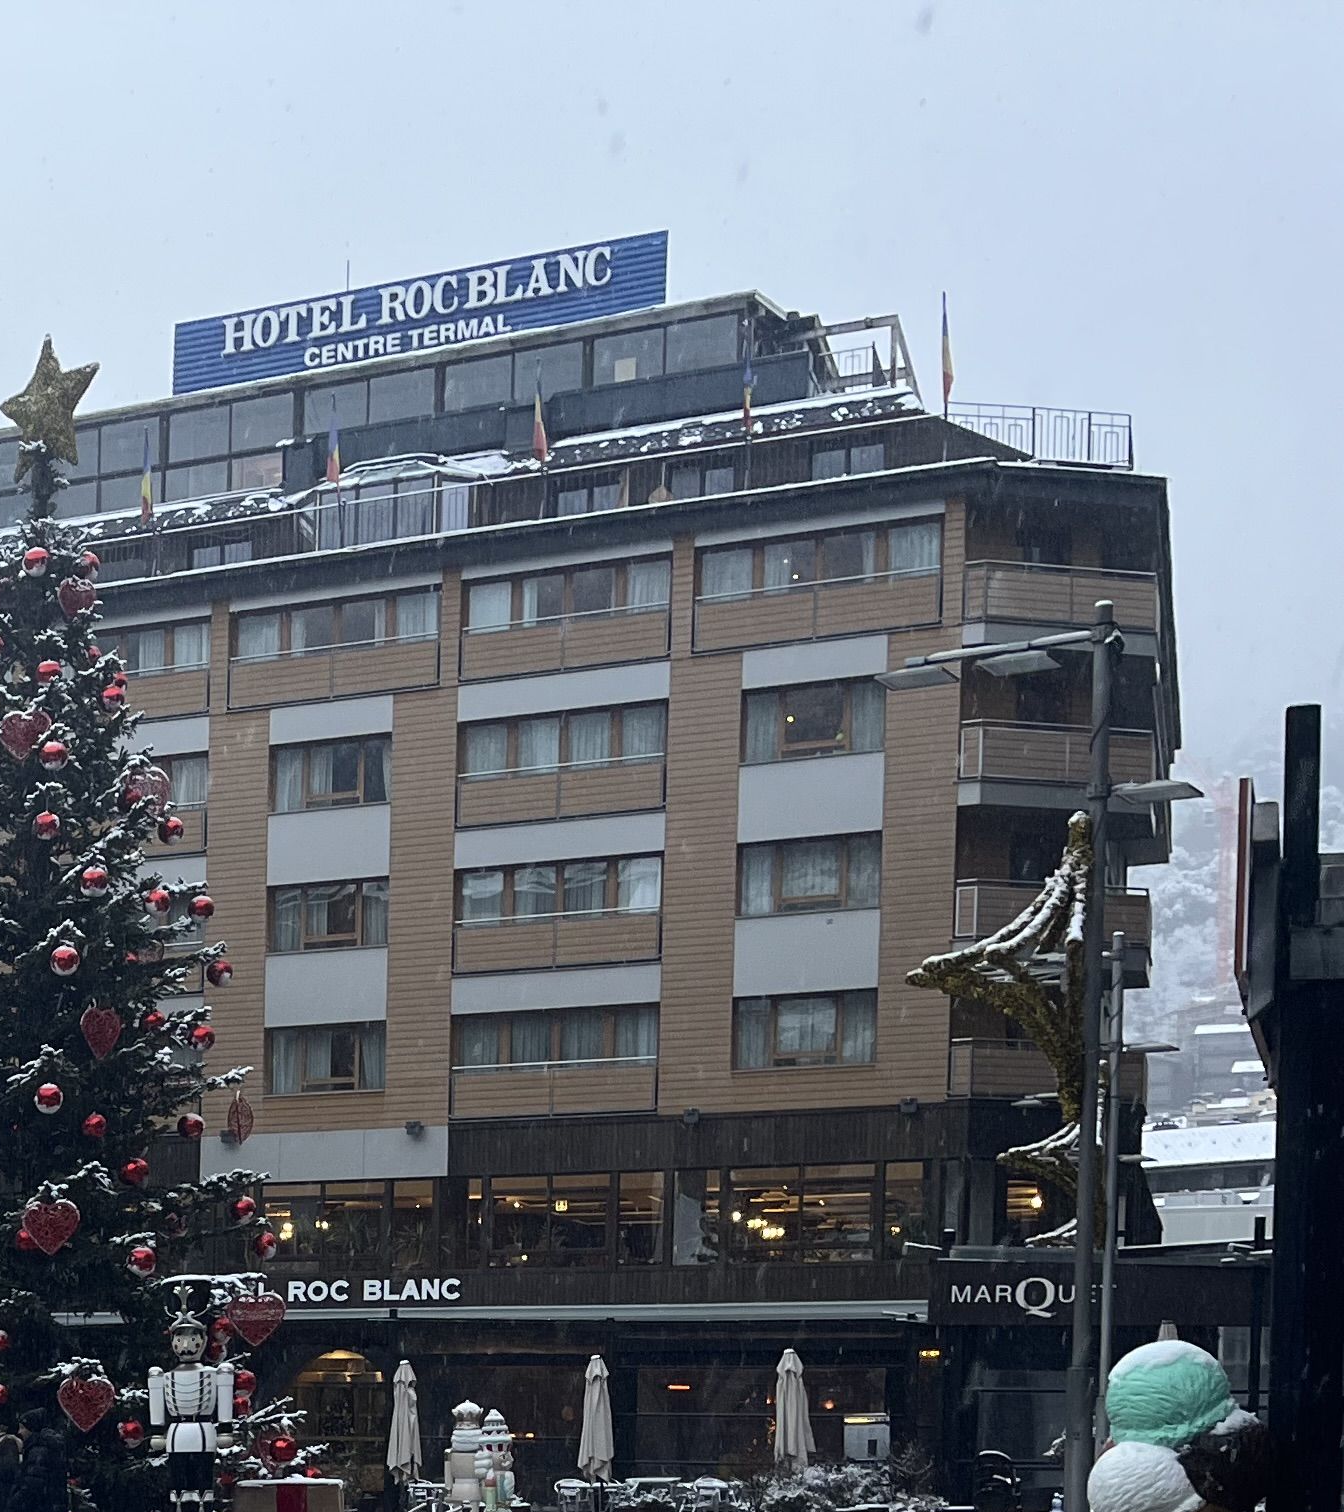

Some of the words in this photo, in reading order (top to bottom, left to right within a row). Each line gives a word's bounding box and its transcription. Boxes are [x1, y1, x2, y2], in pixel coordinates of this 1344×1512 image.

[221, 294, 367, 358] HOTEL
[375, 275, 460, 326] ROC
[463, 246, 612, 310] BLANC
[303, 332, 403, 368] CENTRE
[408, 314, 513, 349] TERMAL
[286, 1279, 351, 1303] ROC
[362, 1277, 462, 1302] BLANC
